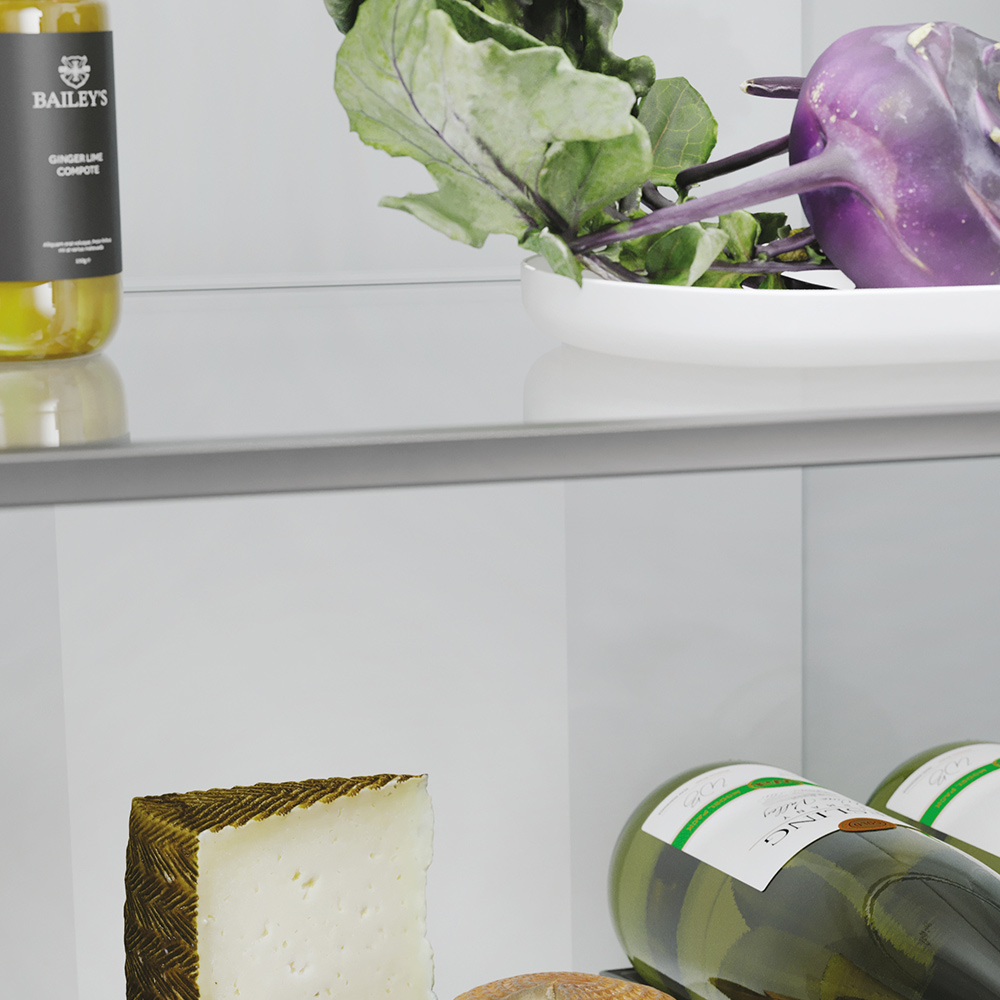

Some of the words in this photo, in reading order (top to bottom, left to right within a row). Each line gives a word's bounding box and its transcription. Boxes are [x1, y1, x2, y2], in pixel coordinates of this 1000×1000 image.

[32, 89, 108, 109] BAILEY'S
[48, 153, 86, 165] GINGER
[56, 165, 100, 177] COMPOTE
